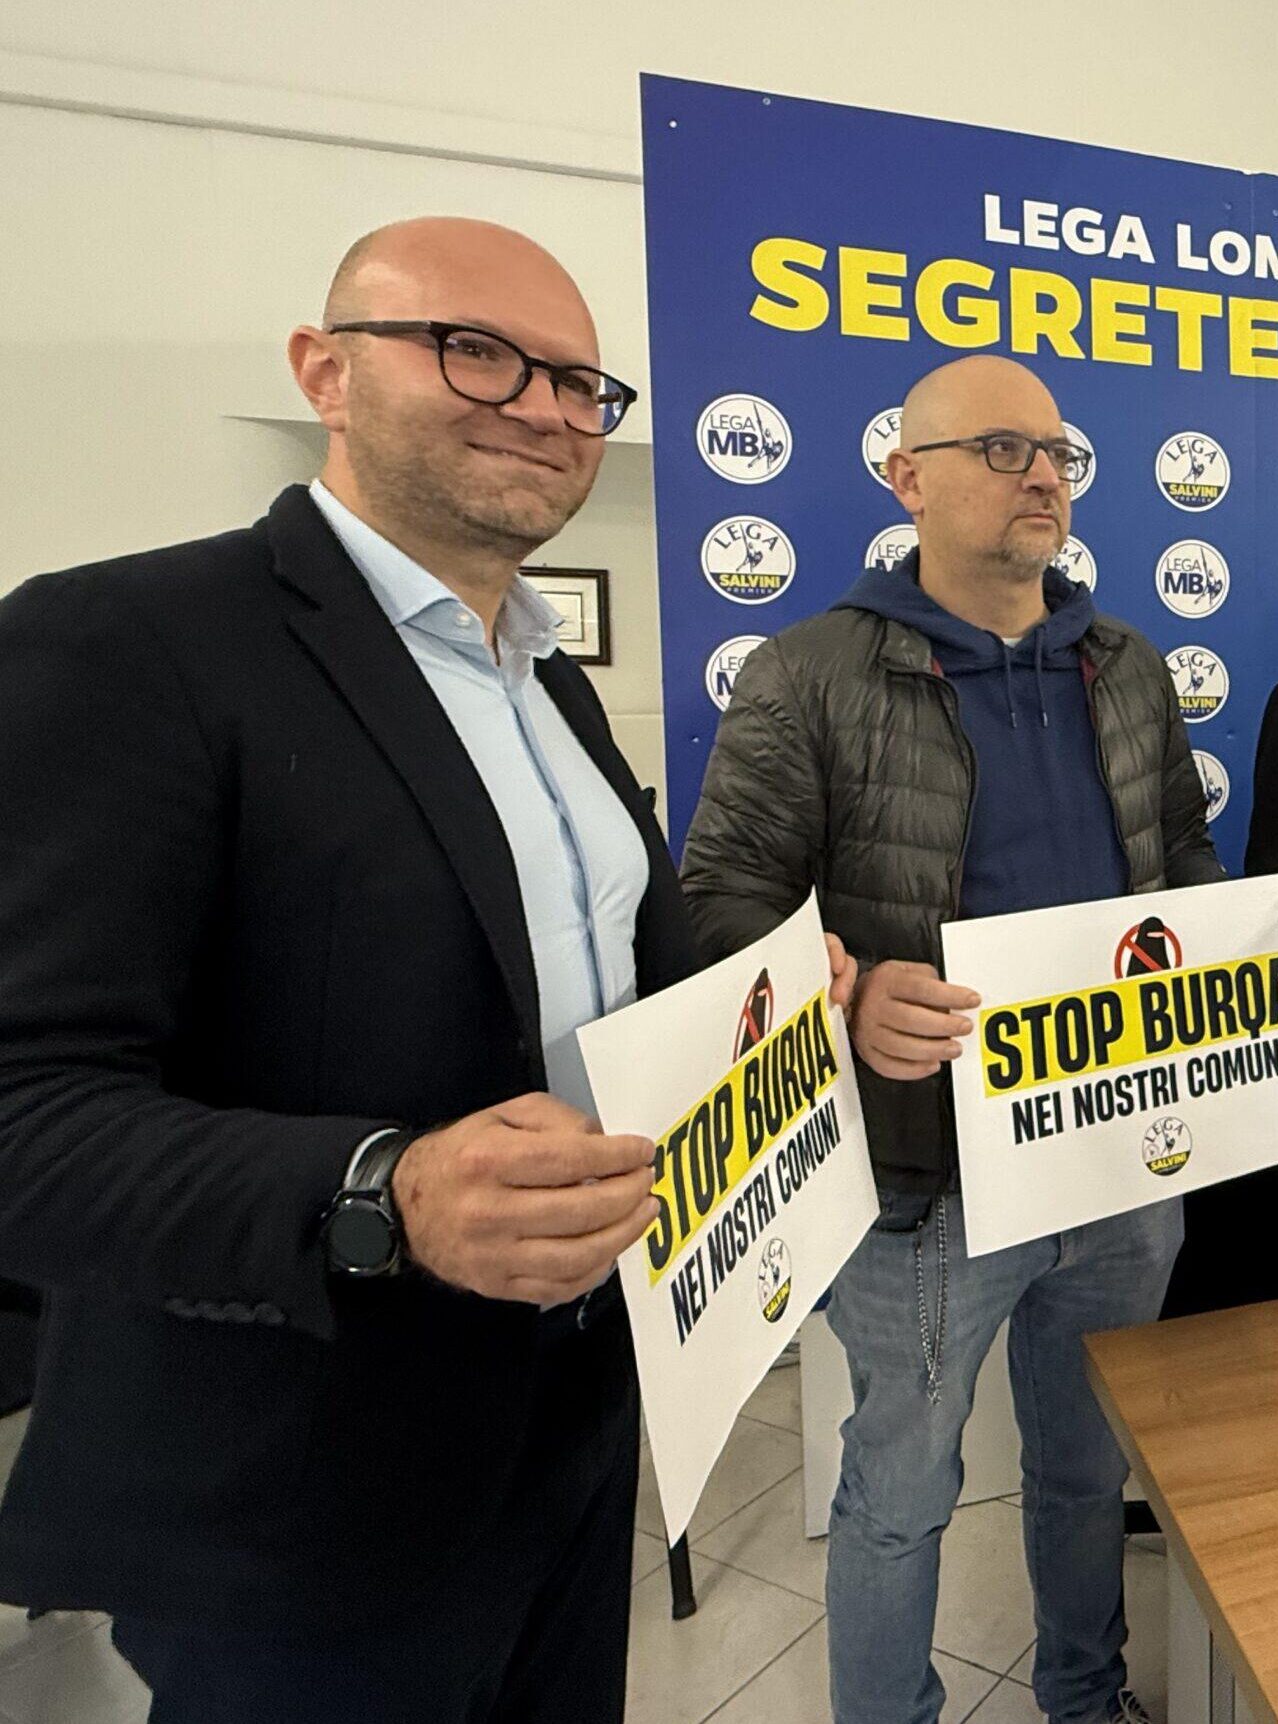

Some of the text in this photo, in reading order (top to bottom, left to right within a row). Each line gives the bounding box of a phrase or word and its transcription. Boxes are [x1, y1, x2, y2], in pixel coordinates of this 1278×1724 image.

[983, 194, 1155, 264] LEGA
[710, 414, 757, 431] LEGA
[707, 430, 760, 457] MB
[1166, 439, 1218, 464] LEGA
[1169, 483, 1218, 498] SALVINI
[714, 523, 779, 551] LEGA
[878, 544, 907, 558] LEG
[1166, 558, 1202, 572] LEGA
[719, 573, 780, 588] SALVINI
[1164, 572, 1204, 595] MB
[1168, 652, 1217, 676] LEGA
[1178, 697, 1217, 708] ALVINI
[984, 991, 1124, 1090] STOP
[1011, 1091, 1064, 1145] NEI
[1072, 1063, 1178, 1128] NOSTRI
[646, 996, 838, 1271] STOP BURQA
[1145, 1118, 1183, 1142] LEGA
[670, 1096, 841, 1347] NEI NOSTRI COMUNI
